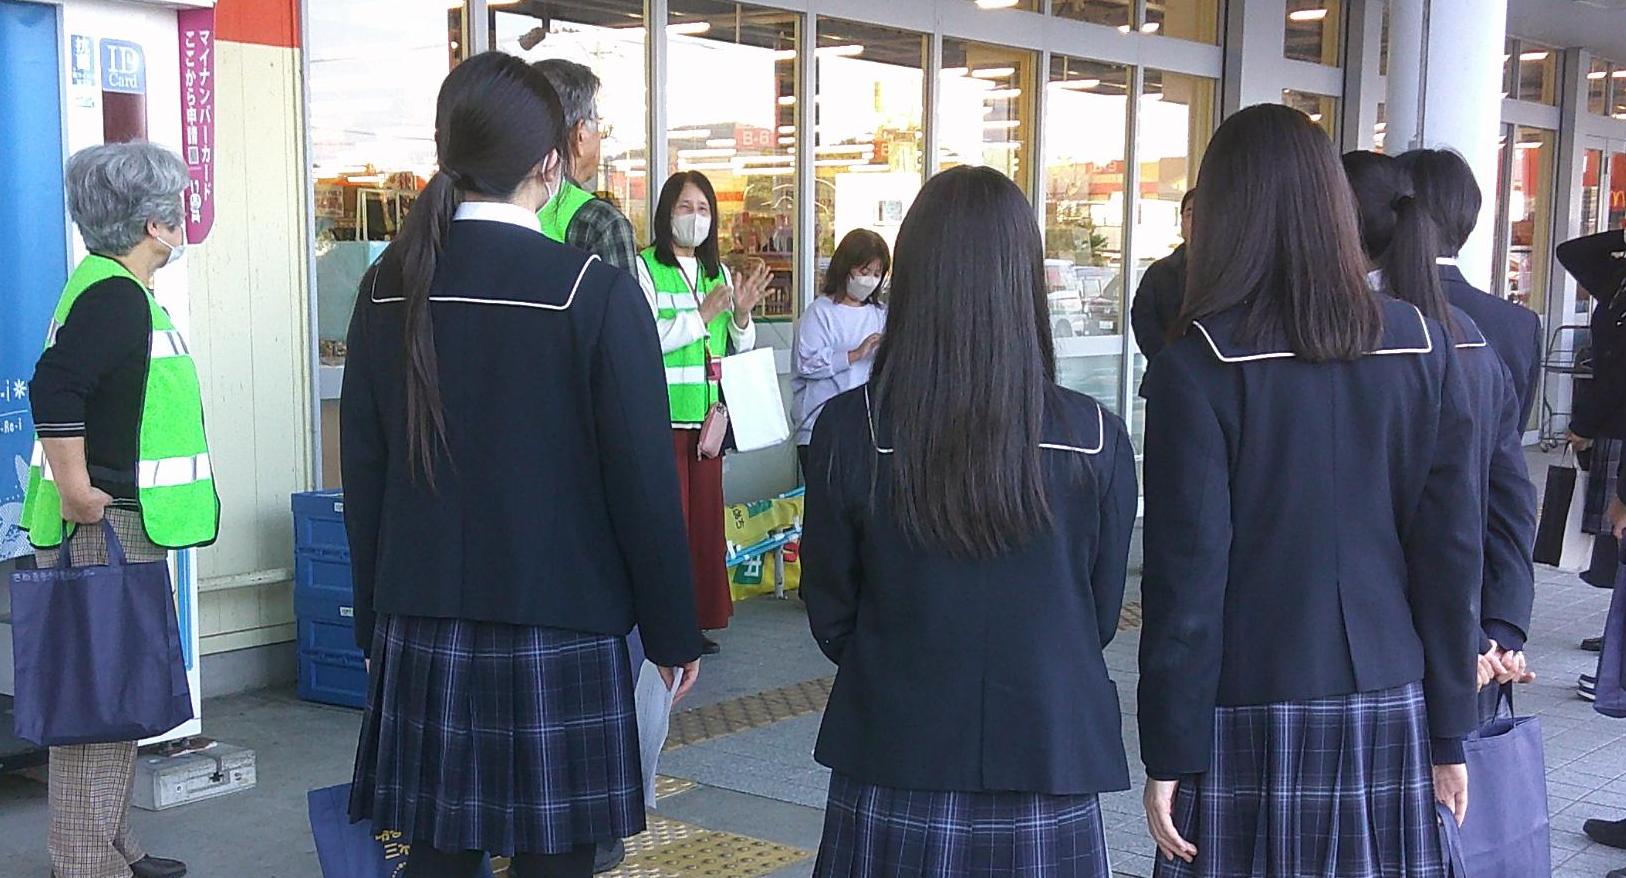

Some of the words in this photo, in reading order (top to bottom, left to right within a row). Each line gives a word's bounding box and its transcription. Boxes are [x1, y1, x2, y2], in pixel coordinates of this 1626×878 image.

[107, 45, 141, 73] ID
[108, 73, 139, 88] Card
[199, 30, 211, 201] マイナンバーカード
